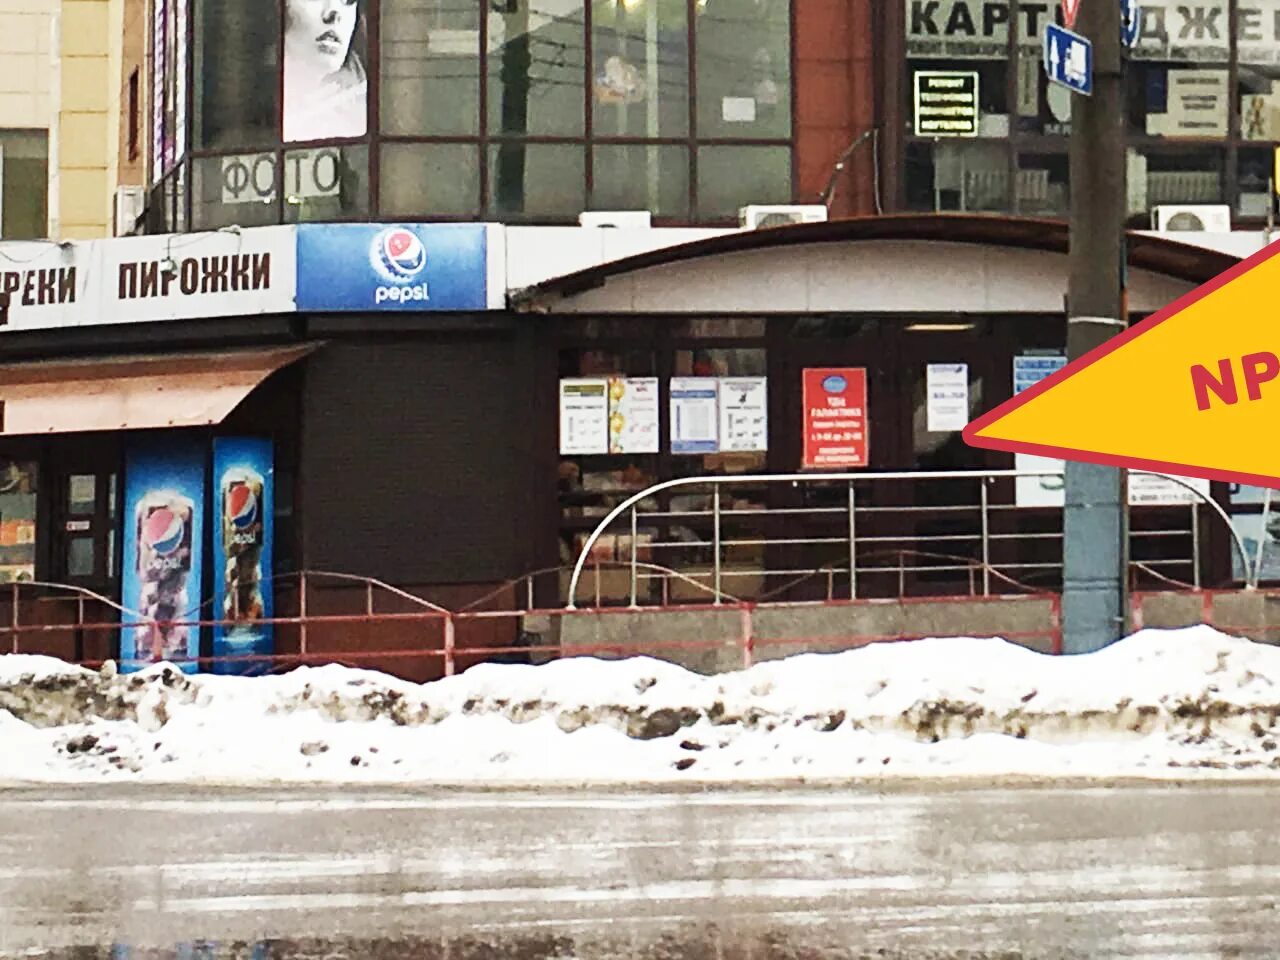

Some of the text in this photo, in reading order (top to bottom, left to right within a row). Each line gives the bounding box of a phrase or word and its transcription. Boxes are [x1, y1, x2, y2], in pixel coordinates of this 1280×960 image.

[225, 150, 340, 199] ФОТО
[0, 267, 76, 306] РЕКИ
[118, 252, 271, 300] ПИРОЖКИ
[376, 282, 429, 303] pepsi
